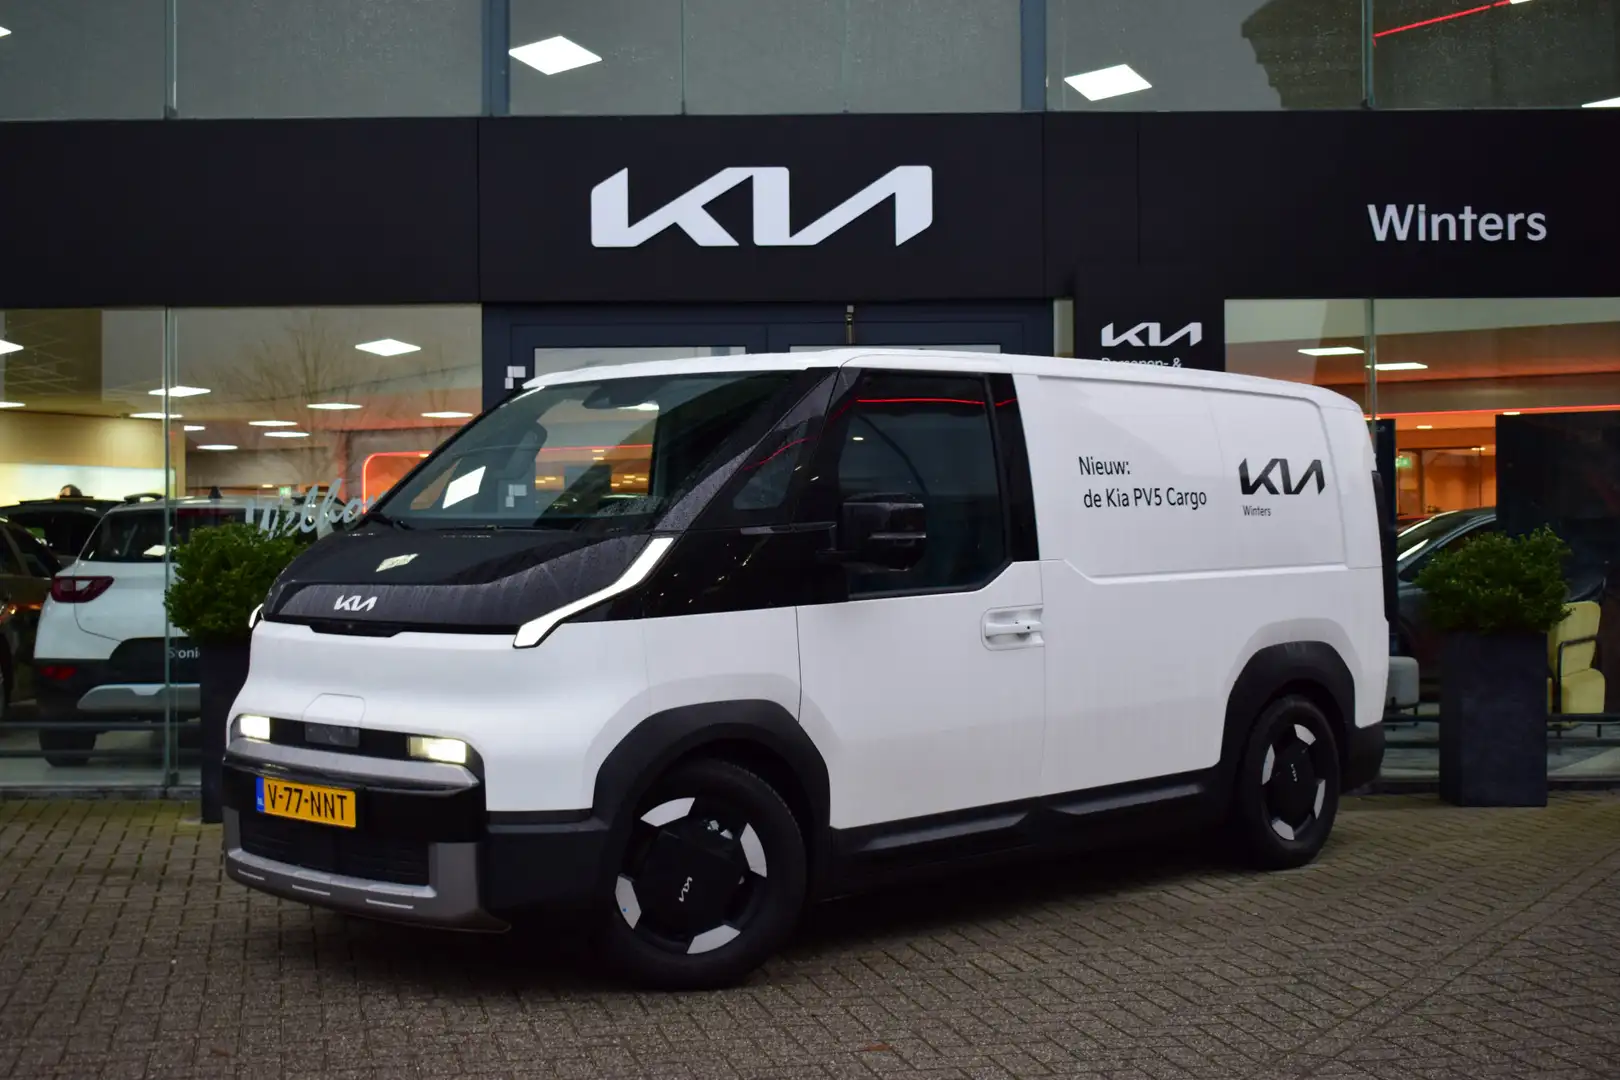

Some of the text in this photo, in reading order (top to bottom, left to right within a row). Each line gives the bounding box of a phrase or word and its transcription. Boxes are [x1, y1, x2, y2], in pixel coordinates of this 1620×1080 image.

[591, 165, 933, 248] KIA
[1366, 203, 1548, 242] Winters
[1101, 321, 1203, 347] KIA
[1078, 456, 1131, 476] Nieuw:
[1238, 458, 1326, 496] KIA
[245, 478, 388, 541] Welko
[1083, 487, 1208, 511] de Kia PV5 Cargo
[1242, 505, 1272, 517] Winters
[267, 784, 347, 821] V-77-NNT
